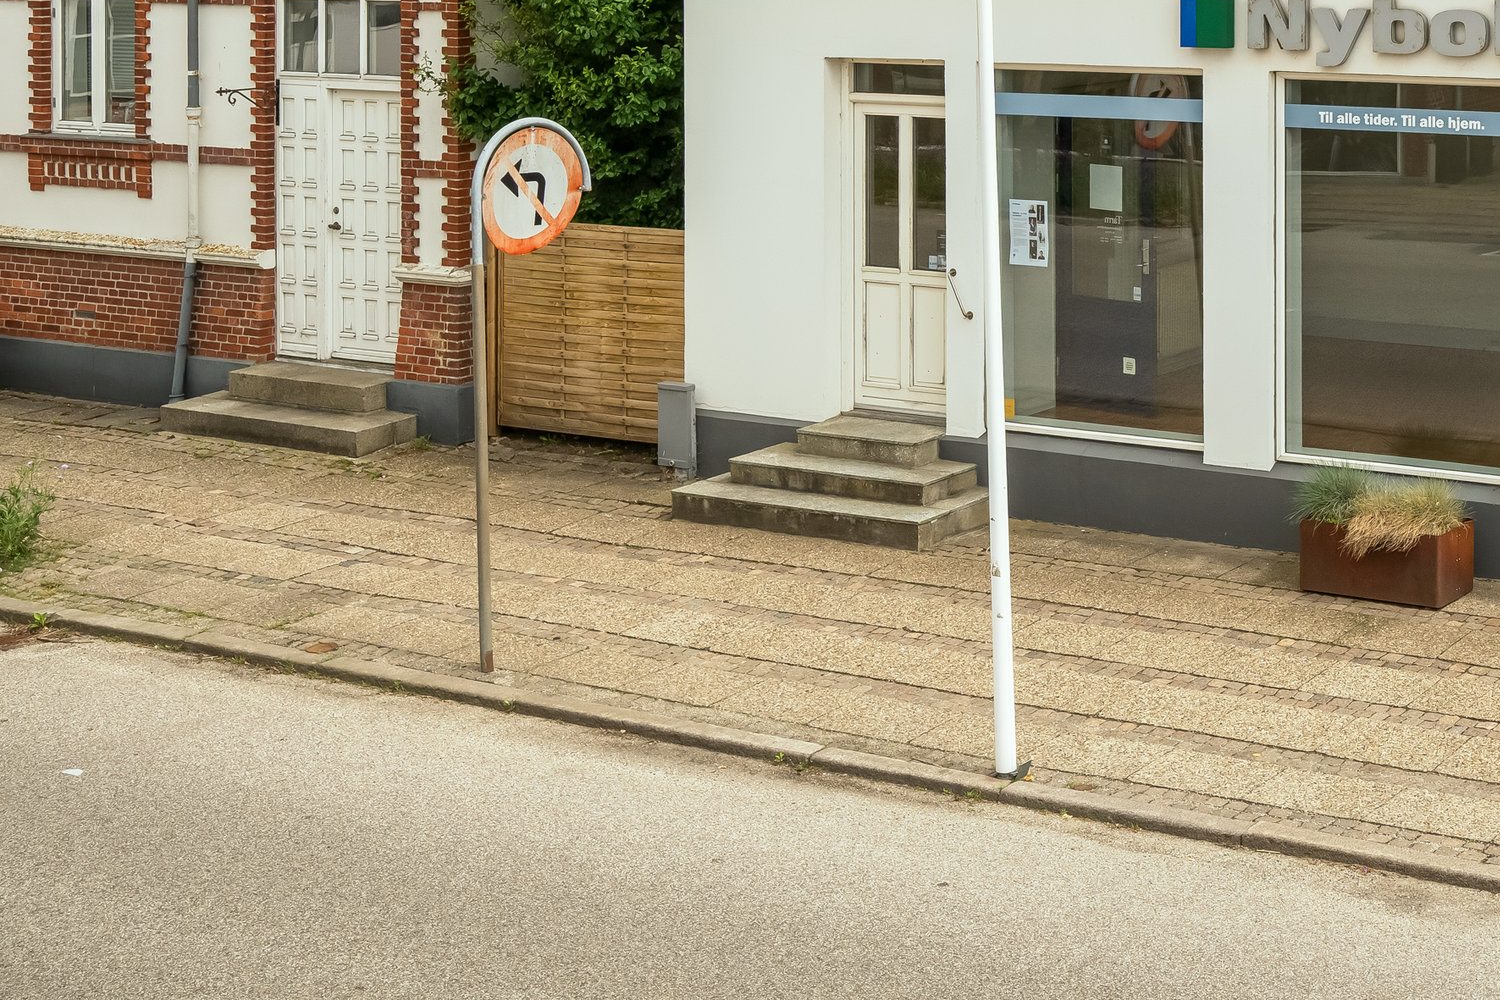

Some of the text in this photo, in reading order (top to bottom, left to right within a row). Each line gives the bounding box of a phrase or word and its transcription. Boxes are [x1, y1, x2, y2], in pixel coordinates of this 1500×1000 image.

[1318, 111, 1485, 132] Til alle tider. Til alle hjem.
